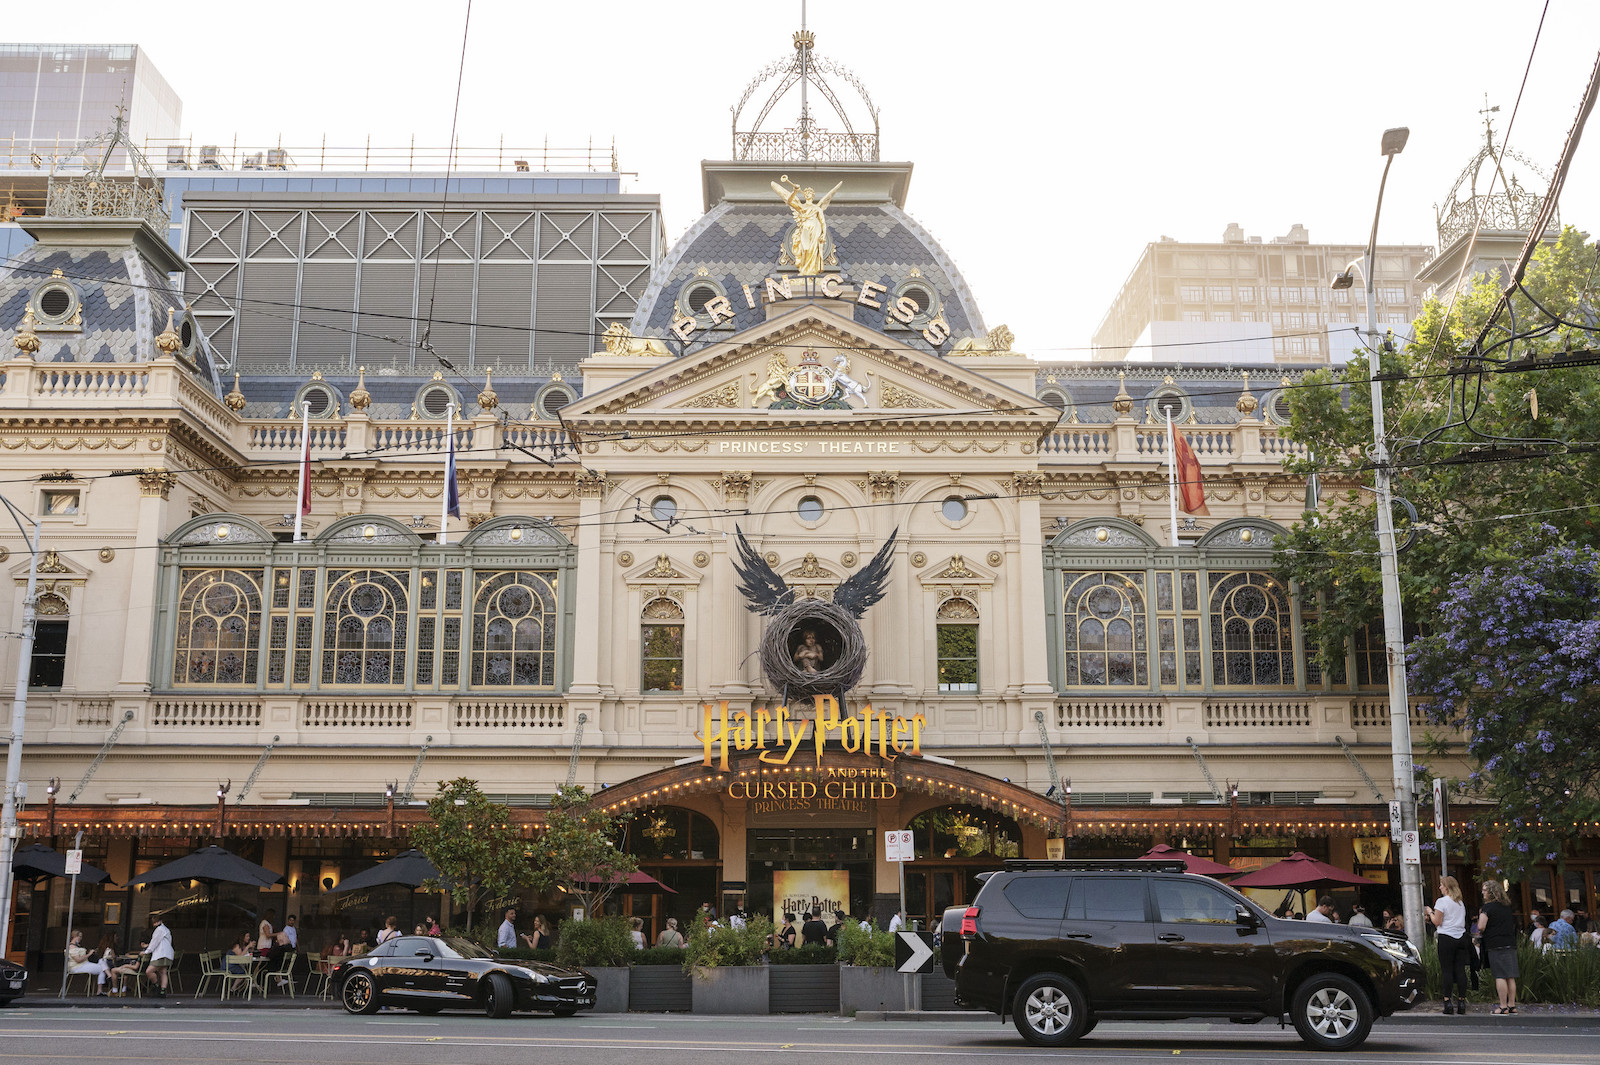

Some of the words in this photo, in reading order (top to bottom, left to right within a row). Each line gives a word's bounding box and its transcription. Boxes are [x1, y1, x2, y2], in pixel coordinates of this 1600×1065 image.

[672, 273, 951, 346] PRINCESS
[819, 441, 900, 454] THEATRE
[694, 700, 809, 772] Harry
[812, 694, 927, 769] Potter
[828, 767, 857, 779] AND
[863, 767, 887, 779] THE
[728, 781, 817, 800] CURSED
[824, 781, 897, 800] CHILD
[754, 799, 811, 814] PRINCESS
[817, 798, 868, 814] THEATRE
[781, 899, 811, 916] Harry
